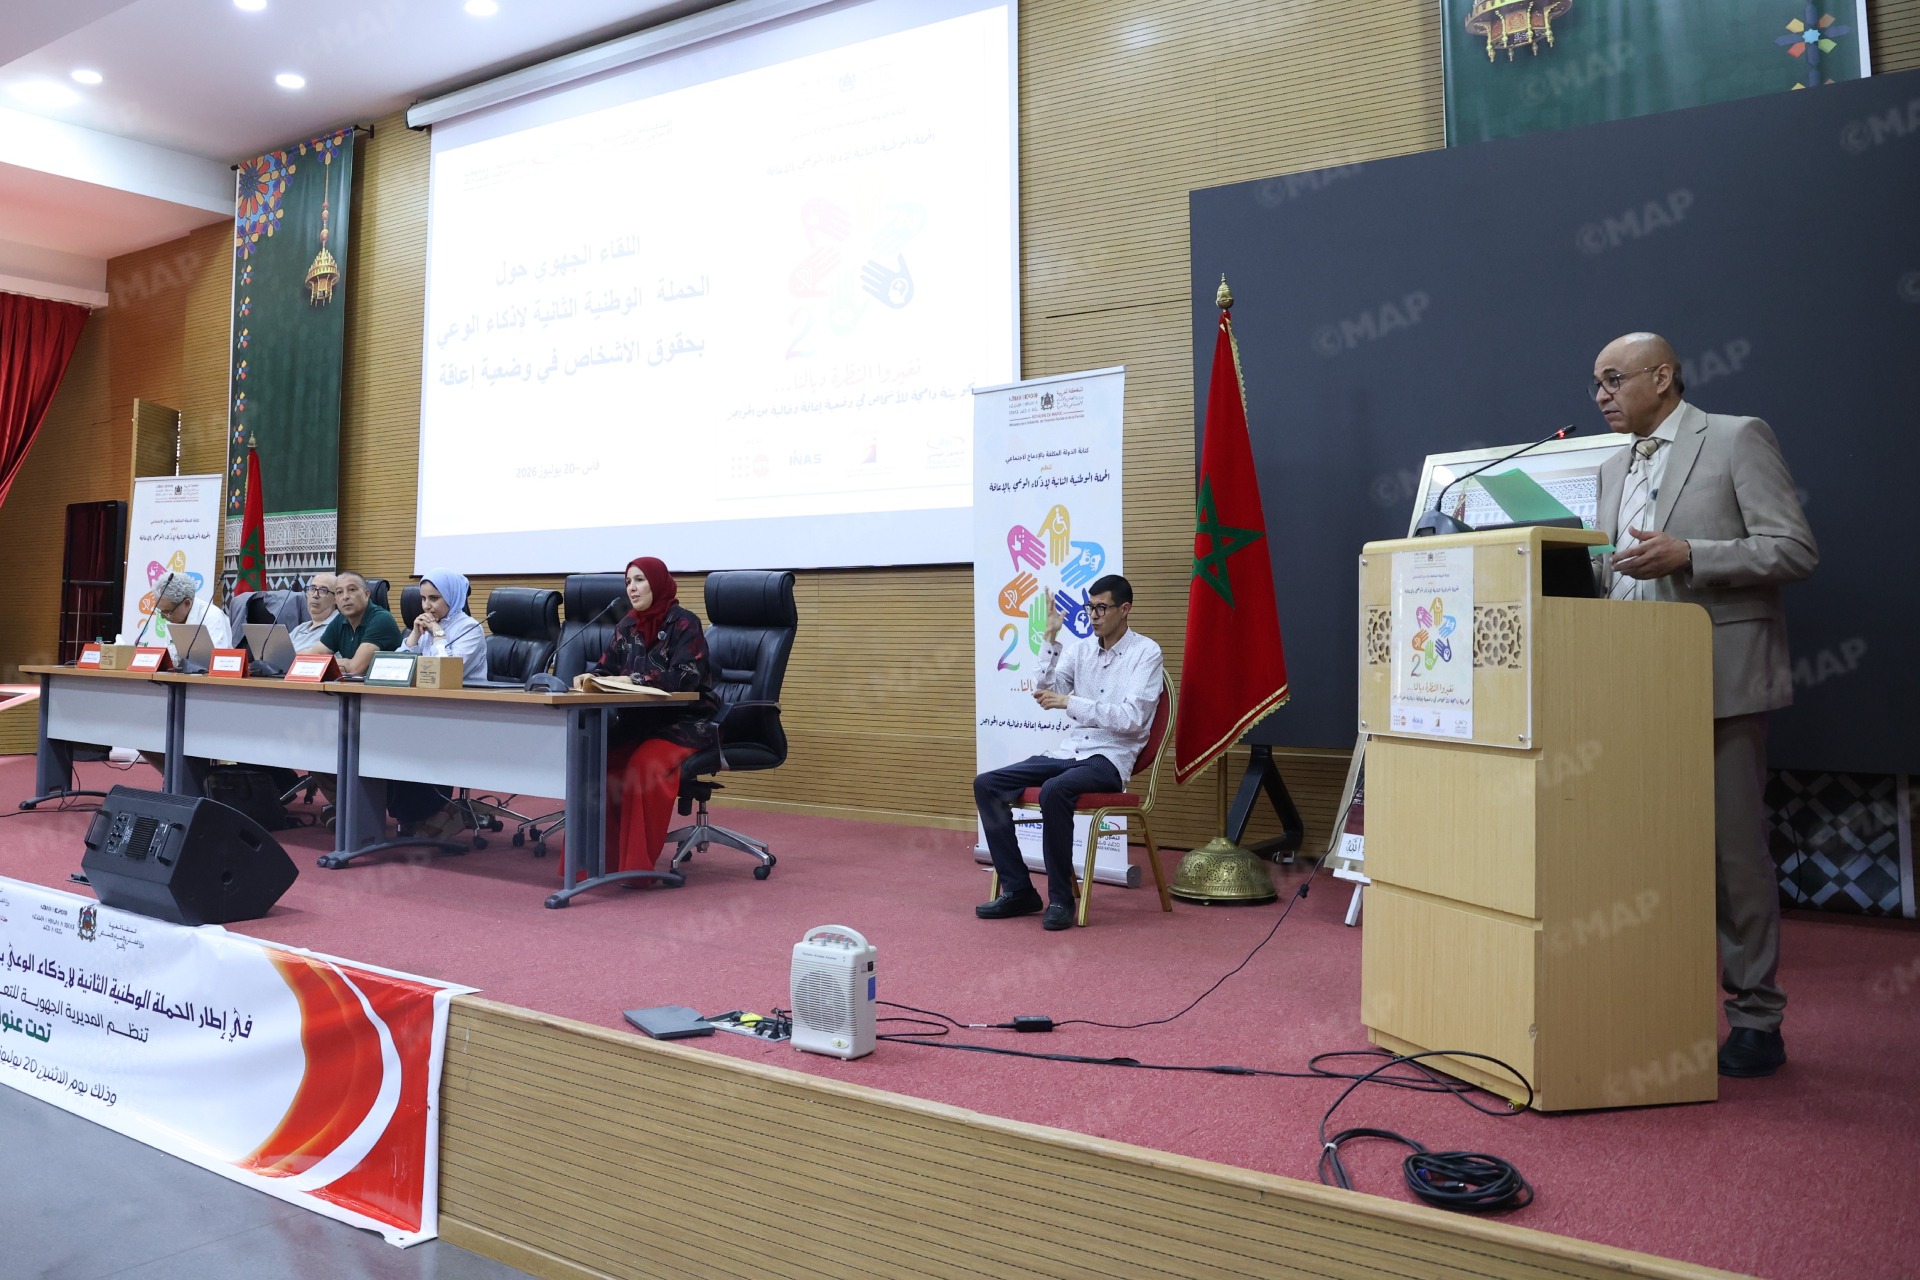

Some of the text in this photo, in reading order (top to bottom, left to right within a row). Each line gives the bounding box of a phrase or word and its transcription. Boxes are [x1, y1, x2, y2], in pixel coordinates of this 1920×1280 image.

[495, 234, 641, 286] اللقاء الجهوي حول
[584, 286, 642, 320] الوطنية
[657, 274, 710, 302] الحملة
[533, 296, 577, 329] الثانية
[436, 314, 479, 349] الوعي
[537, 347, 559, 384] في
[564, 336, 640, 377] الأشخاص
[647, 331, 705, 367] بحقوق
[481, 357, 532, 387] وضعية
[515, 466, 537, 478] 2026
[997, 623, 1020, 671] 2
[7, 941, 35, 972] الوعي
[36, 958, 75, 989] لإذكاء
[76, 968, 108, 995] الثانية
[0, 984, 20, 1000] للتع
[109, 978, 152, 1011] الوطنية
[152, 992, 195, 1022] الحملة
[0, 1010, 52, 1043] تحت عنو
[65, 1003, 104, 1029] المديرية
[198, 1006, 227, 1040] إطار
[228, 1007, 253, 1043] في
[0, 1045, 117, 1107] وذلك يوم الاثنين 20 يوليو
